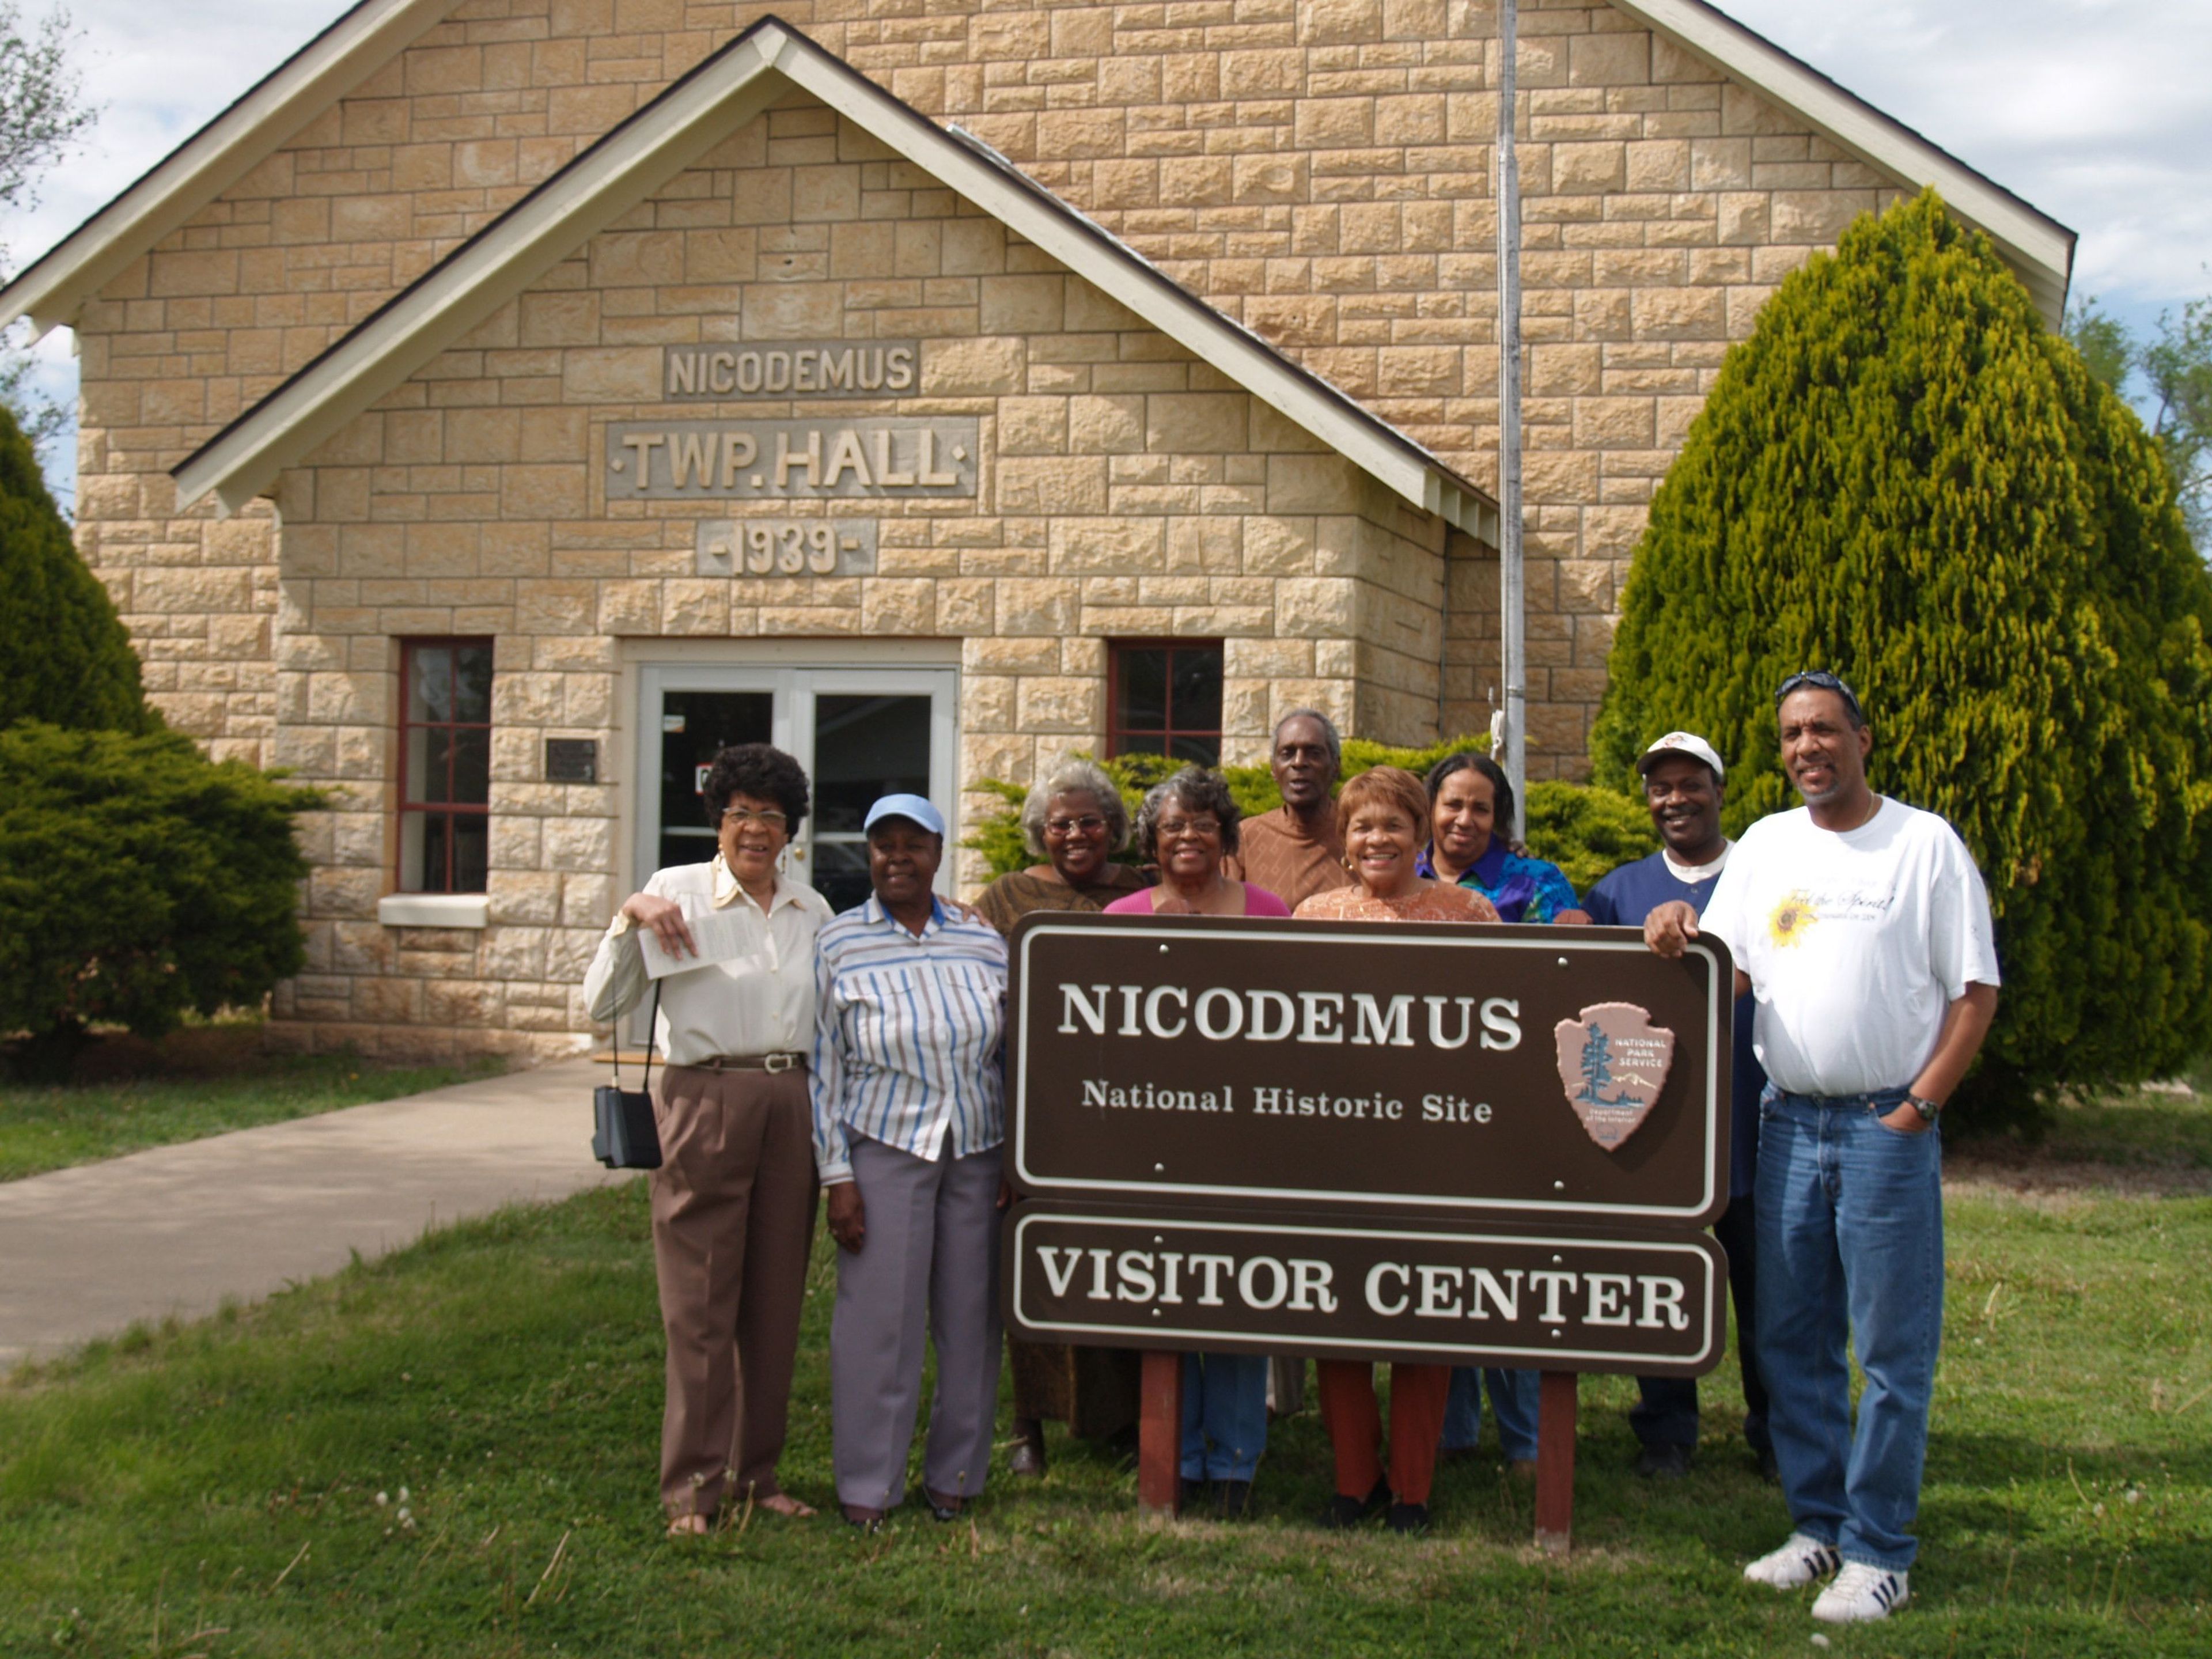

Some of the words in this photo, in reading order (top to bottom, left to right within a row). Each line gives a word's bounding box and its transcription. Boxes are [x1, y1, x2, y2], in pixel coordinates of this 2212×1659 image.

[668, 347, 915, 395] NICODEMUS
[1056, 982, 1522, 1052] NICODEMUS
[1615, 1038, 1666, 1048] NATIONAL
[1619, 1058, 1663, 1068] SERVICE
[1626, 1049, 1654, 1058] PARK
[1082, 1079, 1233, 1113] National
[1252, 1086, 1404, 1121] Historic
[1421, 1094, 1493, 1124] Site
[1036, 1245, 1338, 1315] VISITOR
[1364, 1260, 1690, 1332] CENTER
